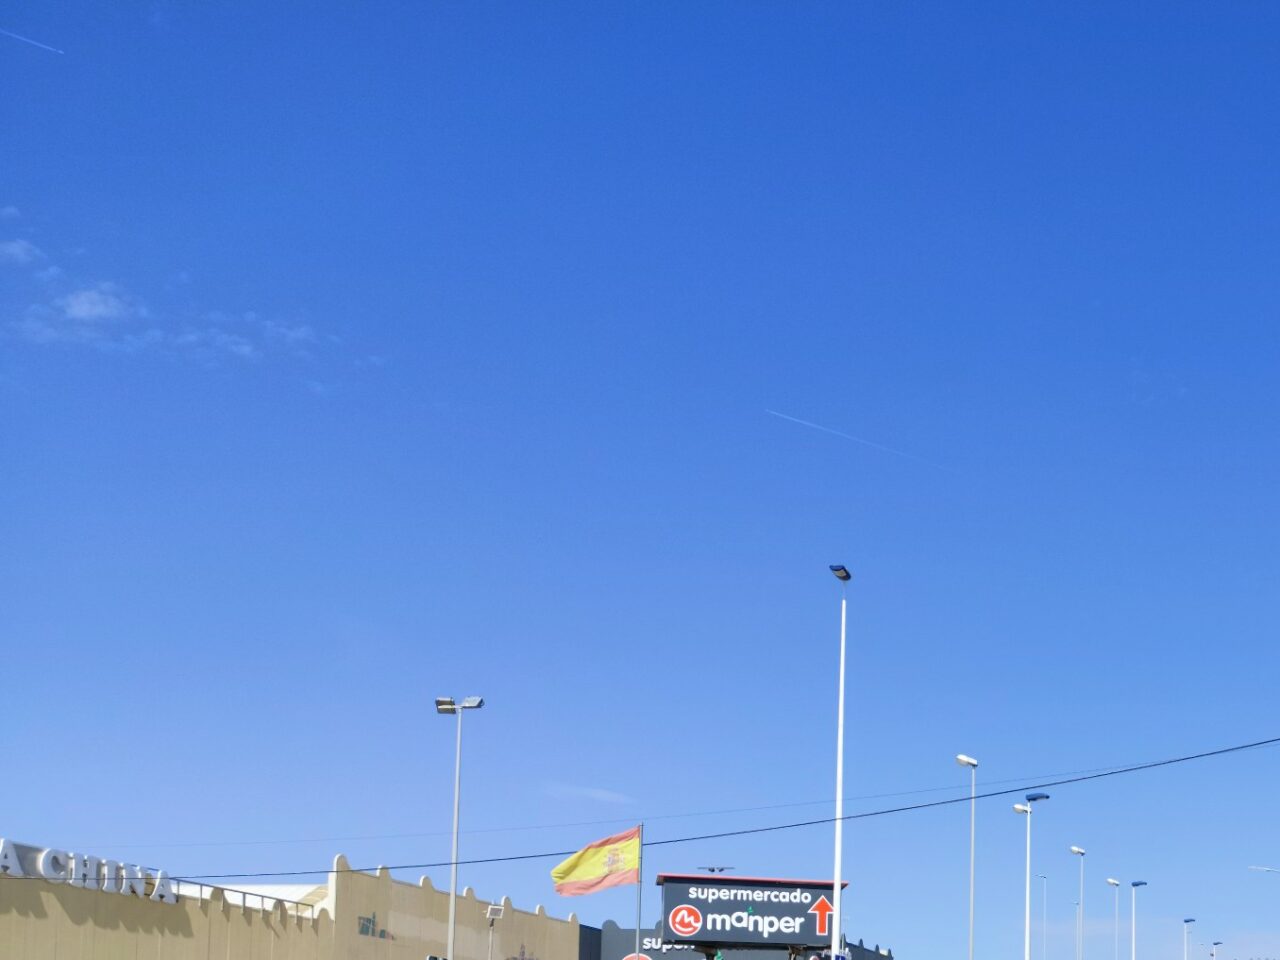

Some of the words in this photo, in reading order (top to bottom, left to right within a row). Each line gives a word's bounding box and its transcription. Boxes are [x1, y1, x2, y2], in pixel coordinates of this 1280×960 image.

[39, 848, 178, 905] CHINA
[688, 886, 812, 903] supermercado
[706, 911, 805, 938] manper
